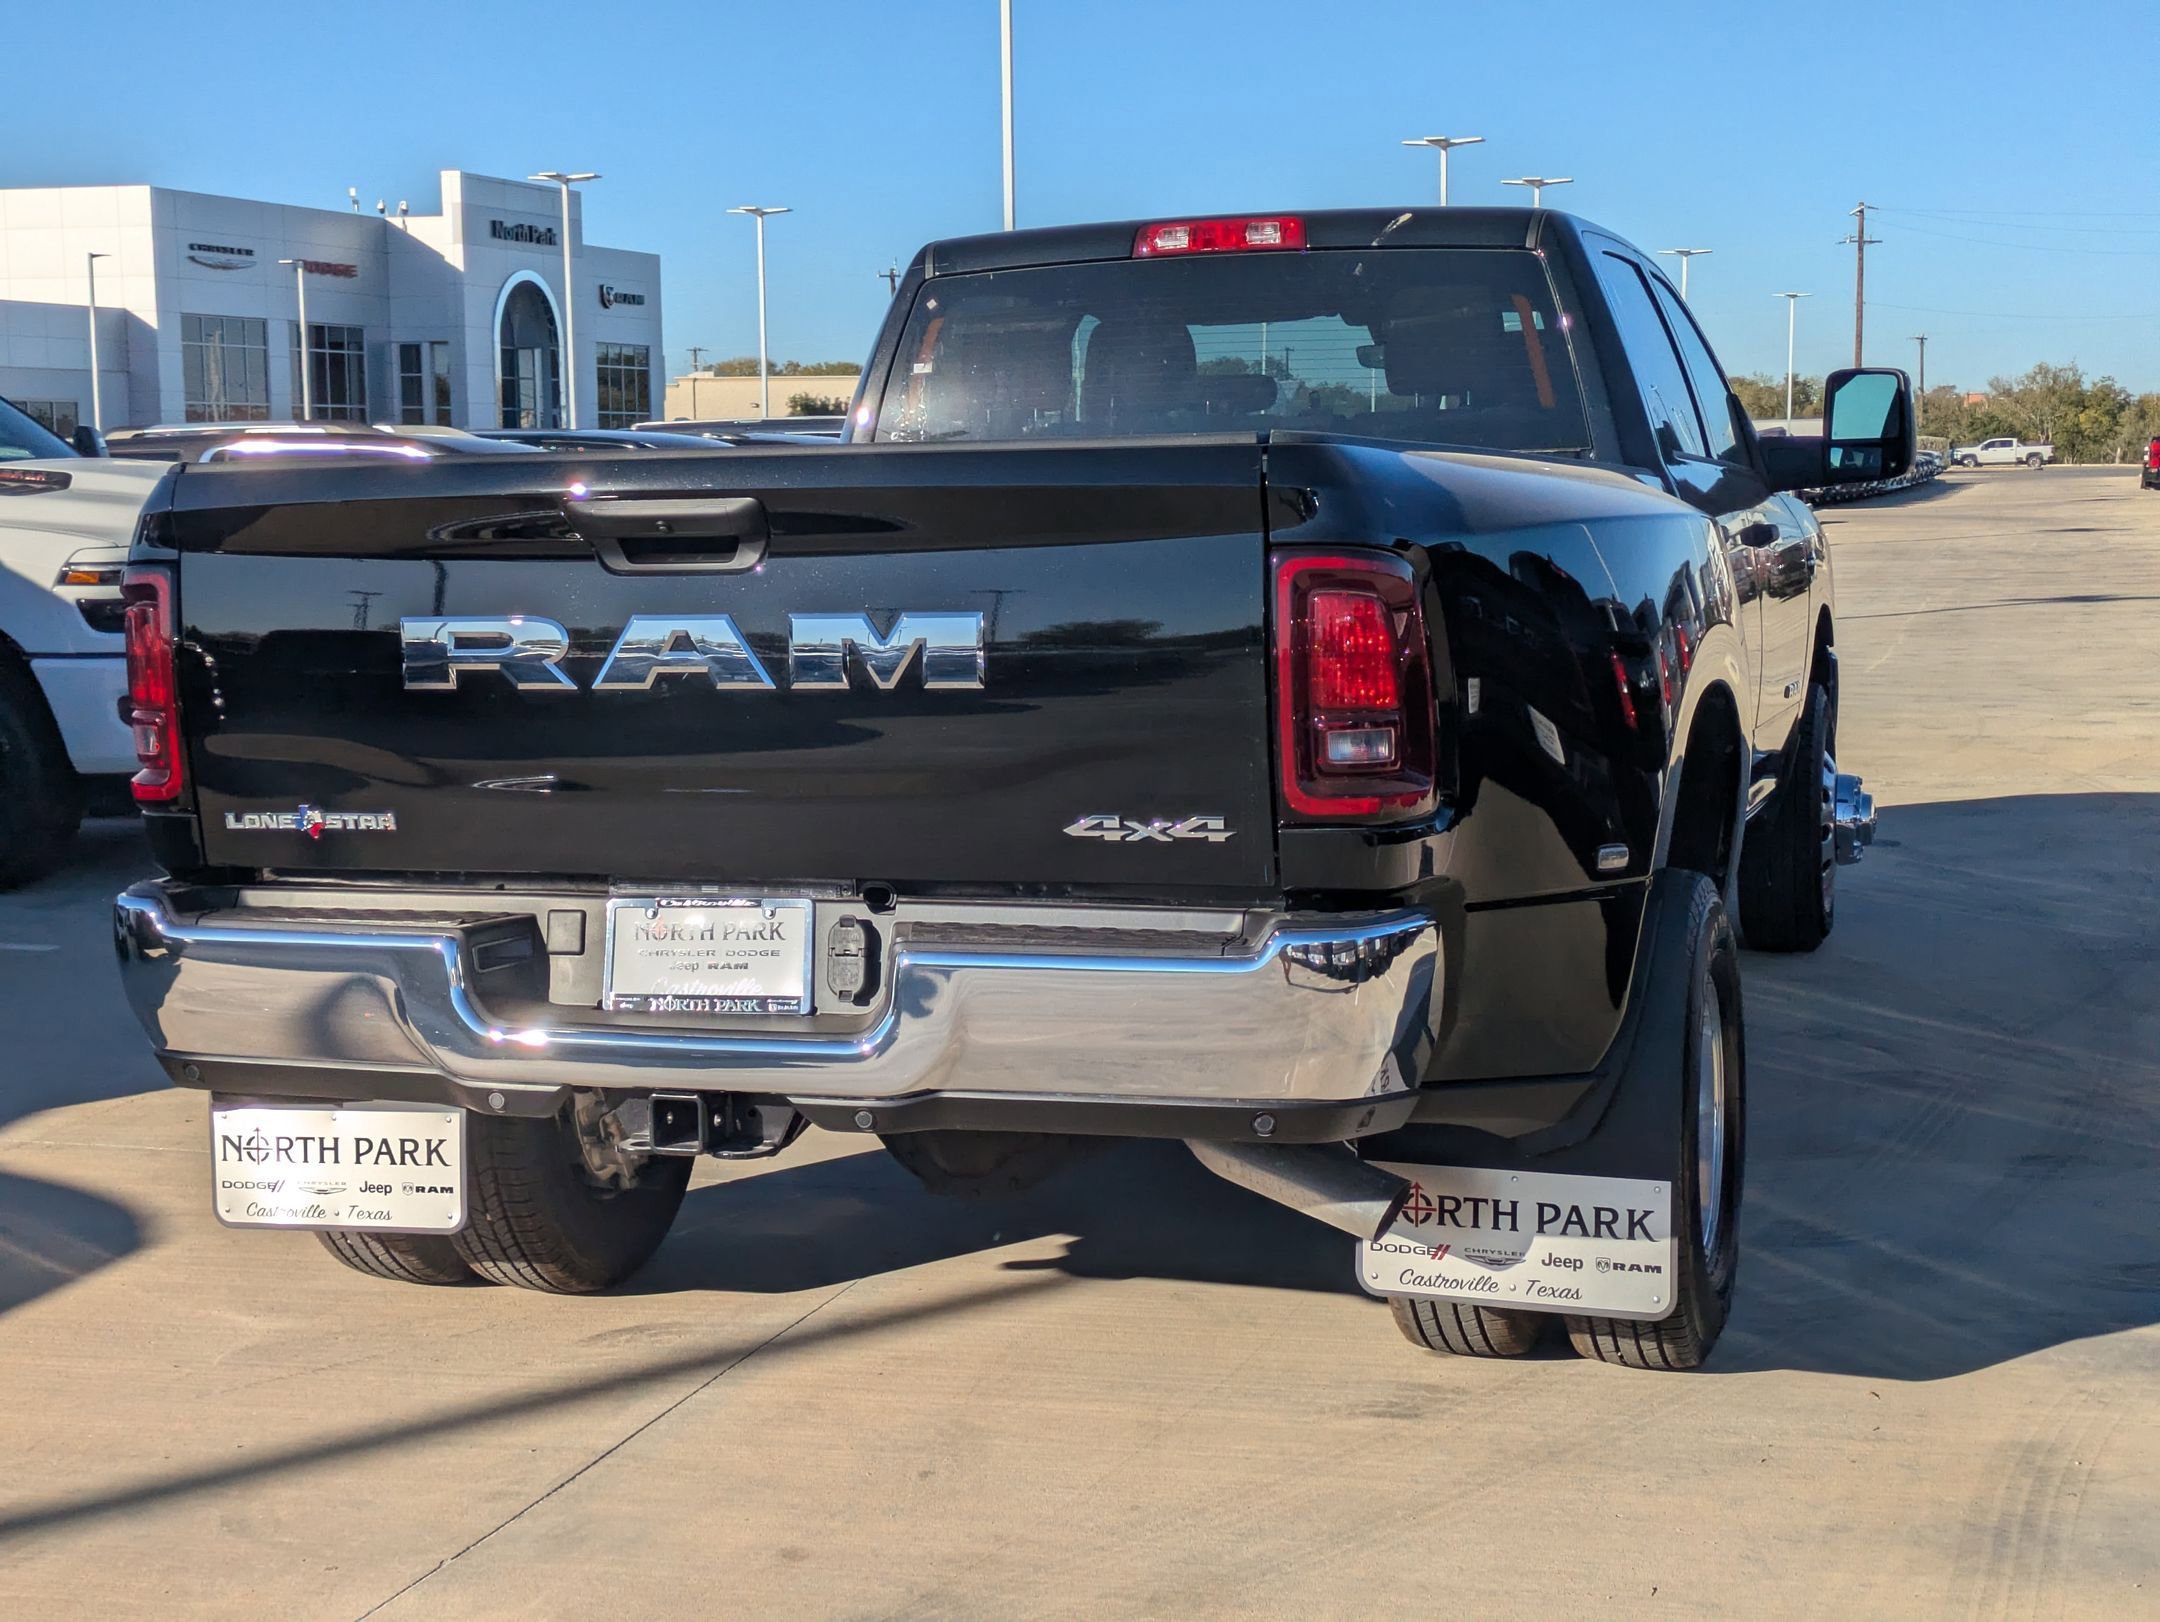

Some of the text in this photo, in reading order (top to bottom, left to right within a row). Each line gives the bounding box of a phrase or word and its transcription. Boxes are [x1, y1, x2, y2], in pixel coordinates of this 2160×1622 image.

[490, 220, 557, 245] North Park
[400, 613, 985, 689] RAM
[225, 812, 396, 830] LONE STAR
[722, 921, 786, 941] PARK
[640, 949, 780, 957] CHRYSLER DODGE
[707, 962, 749, 970] RAM
[648, 997, 762, 1012] NORTH PARK
[222, 1131, 453, 1167] NORTH PARK
[222, 1180, 277, 1191] DODGE
[359, 1181, 393, 1196] Jeep
[415, 1185, 454, 1194] RAM
[347, 1205, 393, 1221] Texas
[1393, 1190, 1660, 1243] ORTH PARK
[1370, 1242, 1662, 1274] DODGE CHRYSLER Jeep RAM
[1400, 1268, 1582, 1301] Castroville Texas
